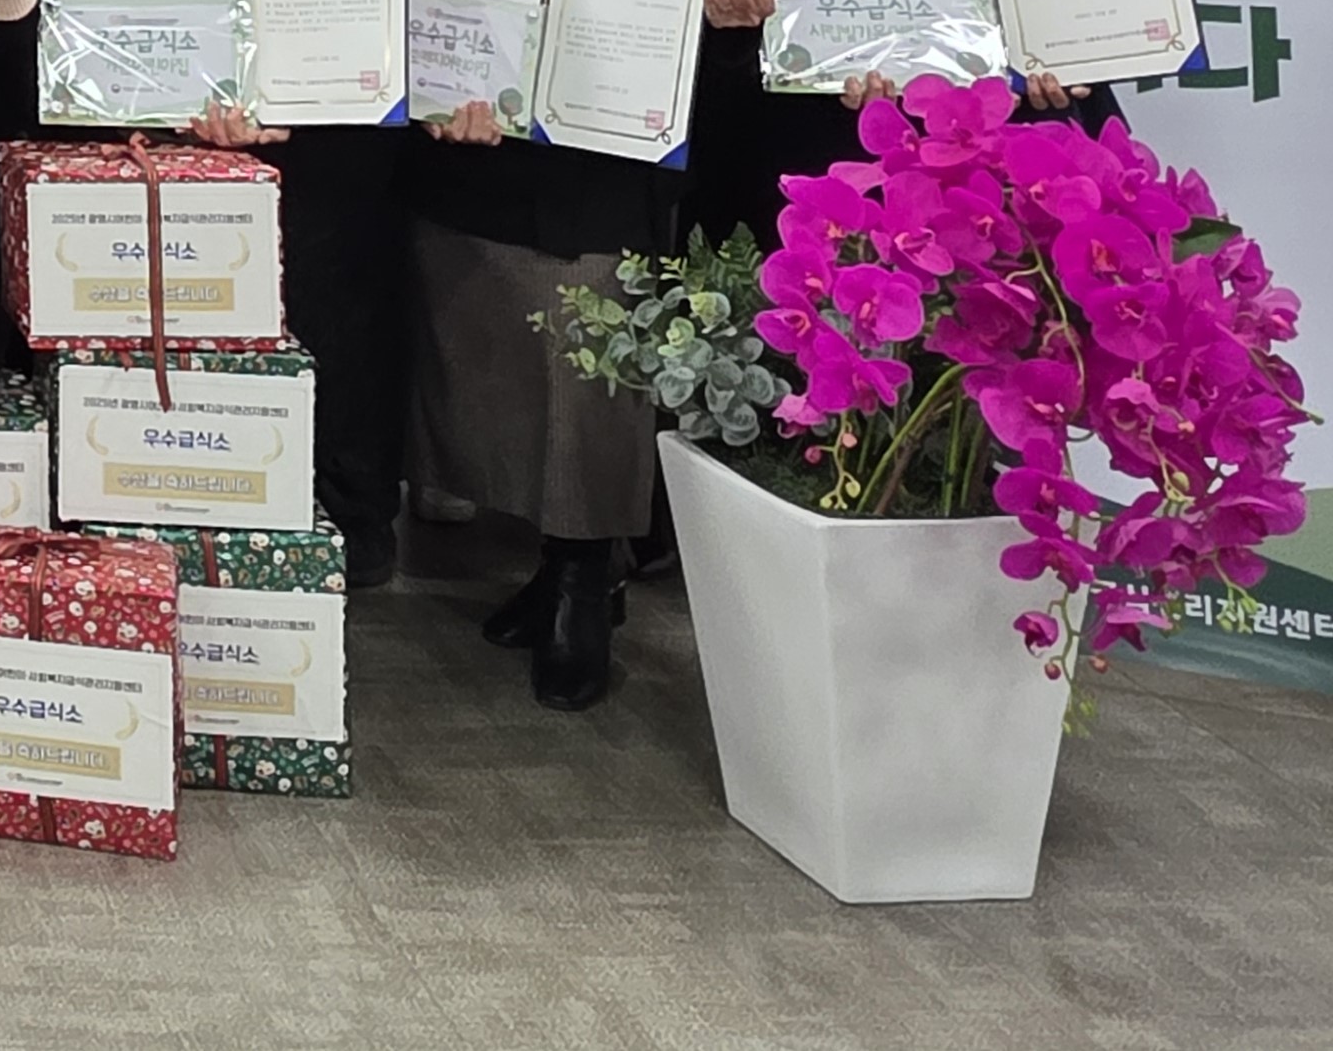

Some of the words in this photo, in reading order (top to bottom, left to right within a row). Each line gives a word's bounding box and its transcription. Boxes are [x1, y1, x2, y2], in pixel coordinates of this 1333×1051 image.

[94, 30, 200, 54] 우수급식소
[409, 19, 495, 54] 우수급식소
[112, 242, 199, 260] 우수식소
[144, 428, 233, 450] 우수급식소
